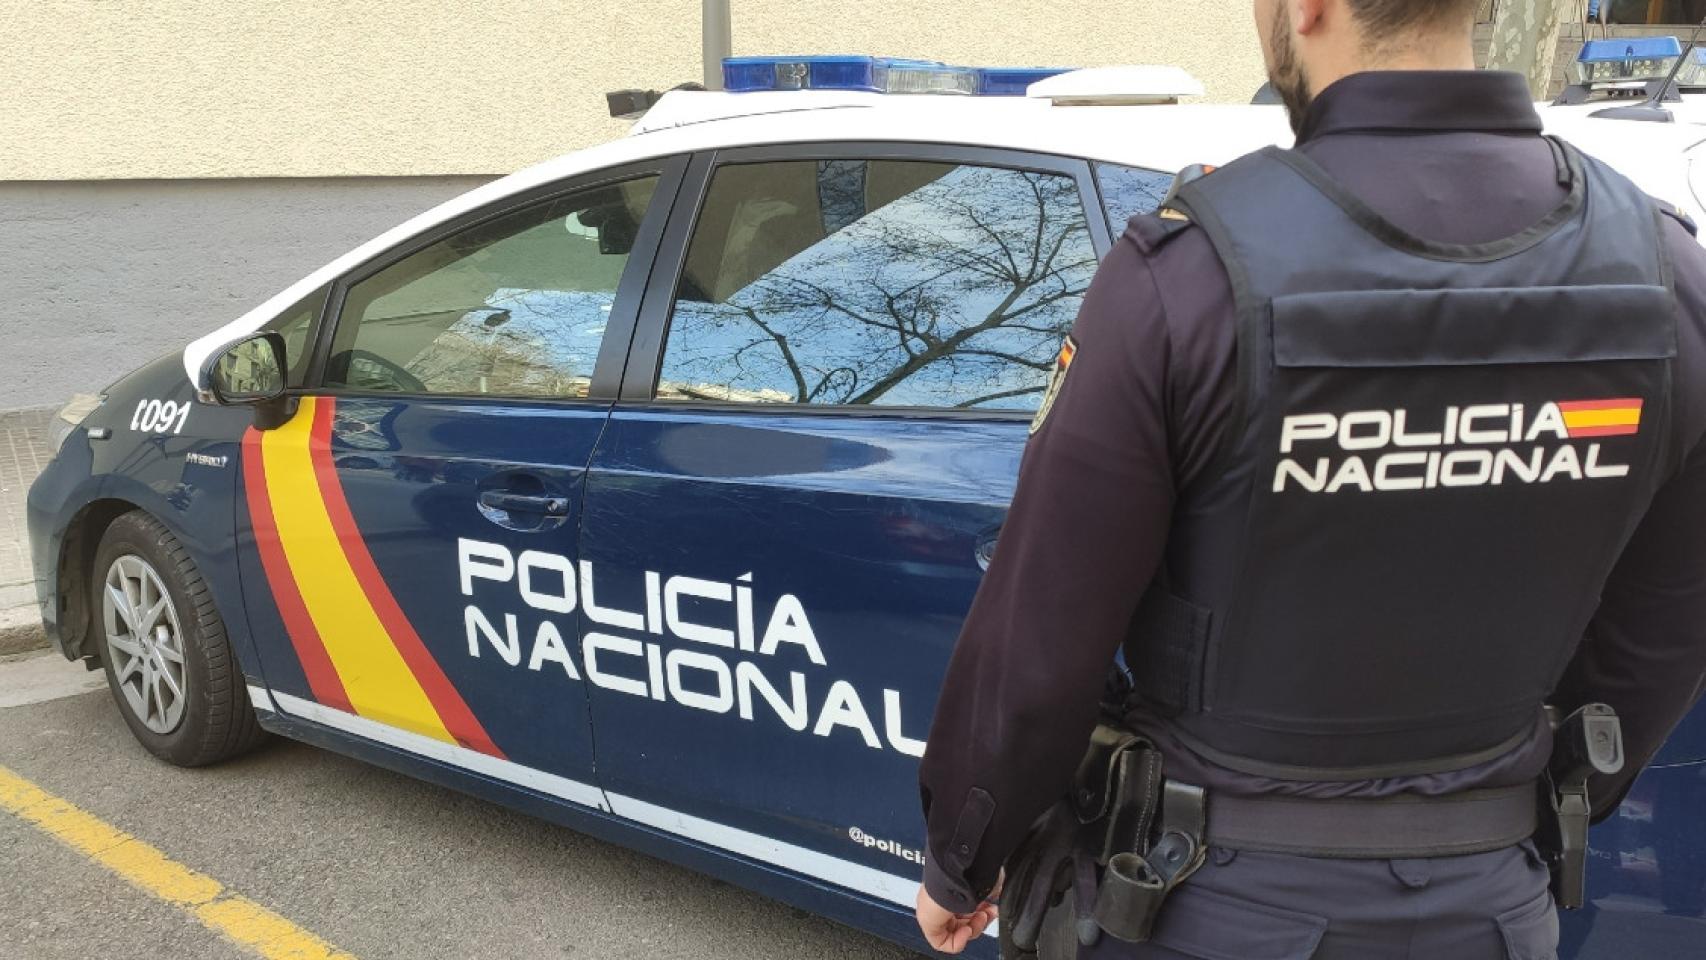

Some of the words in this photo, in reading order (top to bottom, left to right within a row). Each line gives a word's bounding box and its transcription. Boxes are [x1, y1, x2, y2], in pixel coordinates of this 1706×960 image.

[140, 399, 191, 434] 091
[1272, 444, 1630, 493] NACIONAL
[458, 537, 827, 666] POLICÍA
[464, 605, 928, 758] NACIONAL
